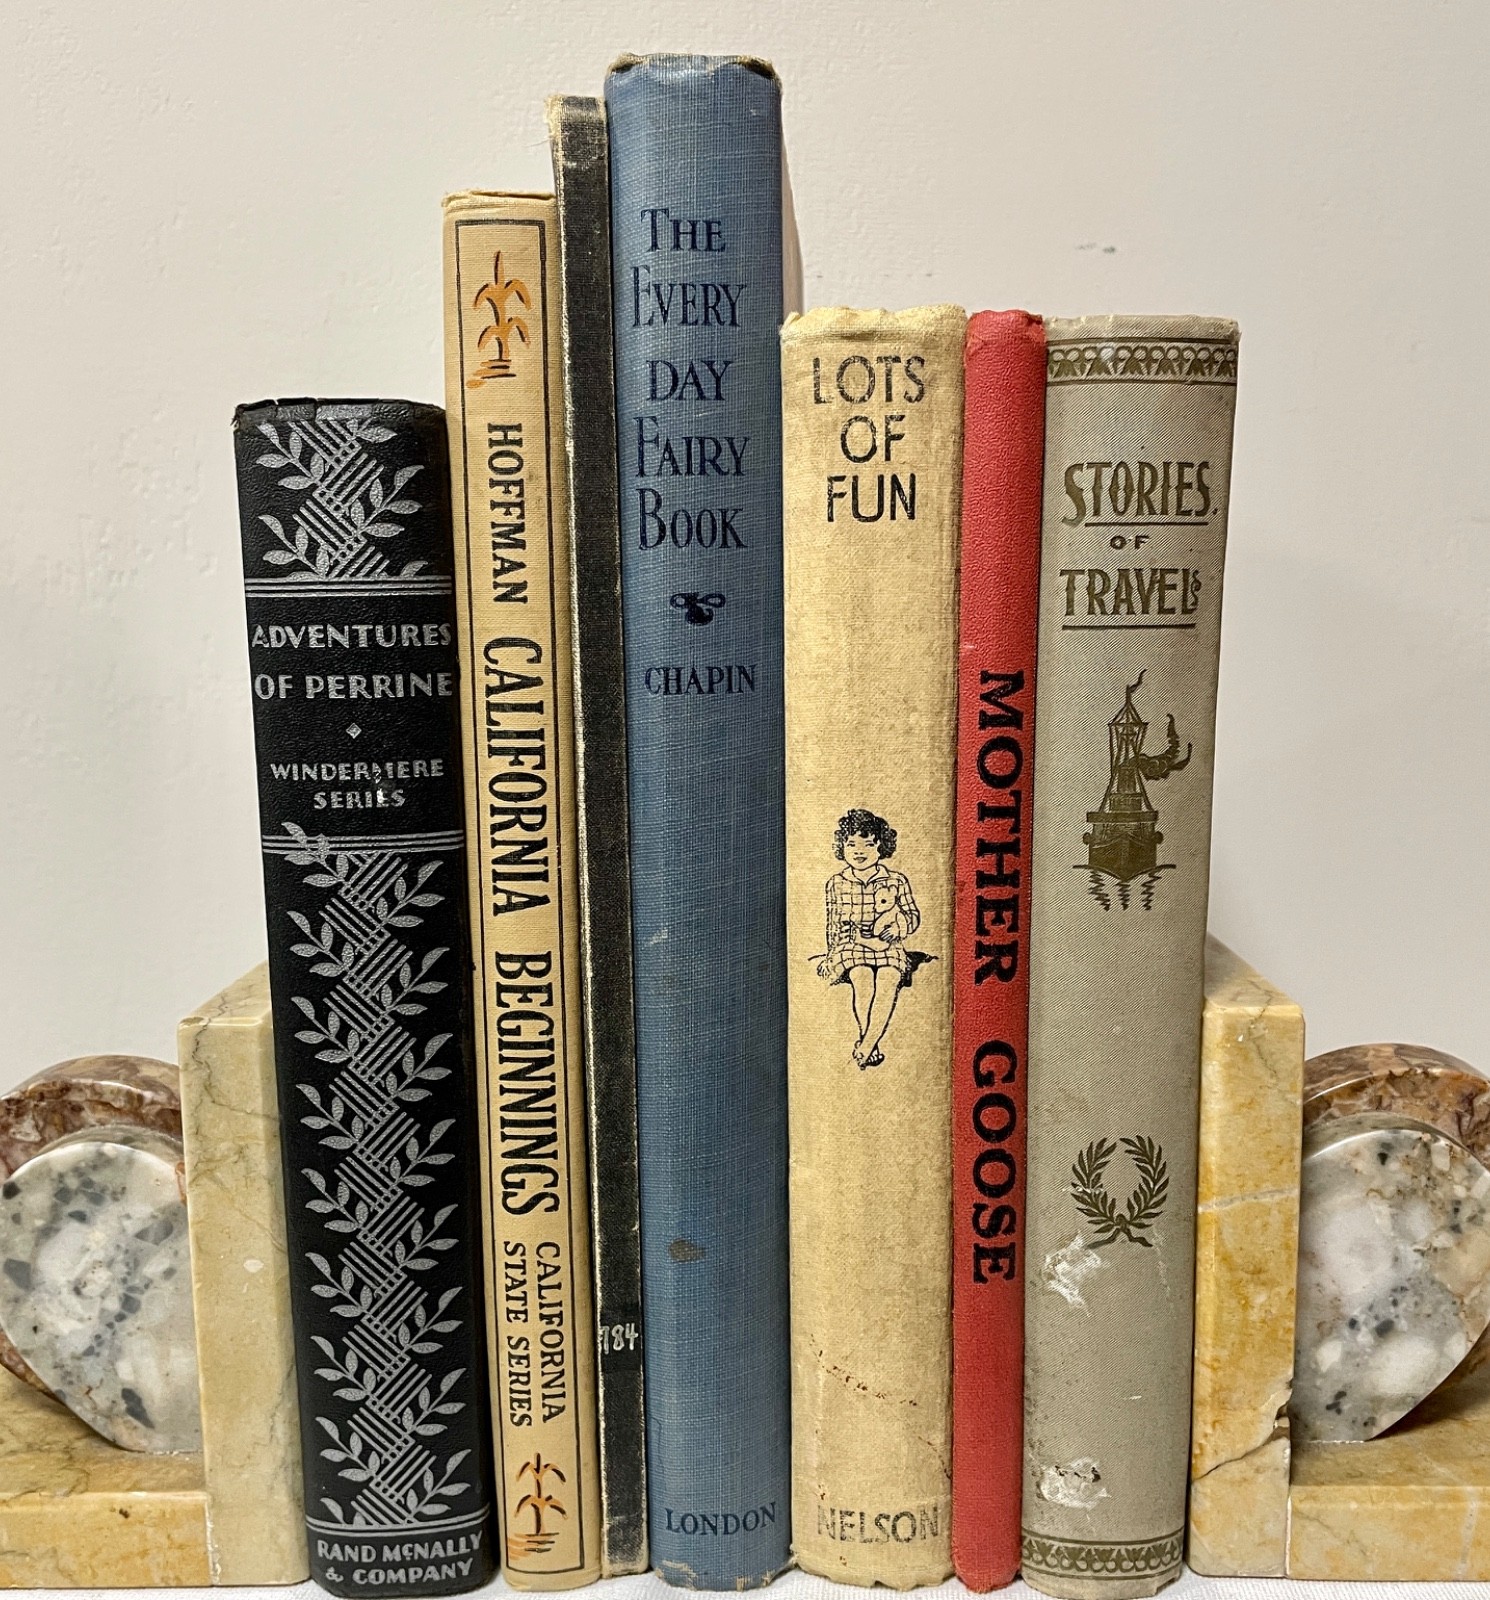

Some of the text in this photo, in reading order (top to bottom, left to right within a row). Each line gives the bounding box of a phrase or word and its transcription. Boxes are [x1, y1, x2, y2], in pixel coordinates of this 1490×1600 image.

[640, 208, 726, 252] THE
[632, 265, 746, 328] EVERY
[648, 359, 733, 401] DAY
[812, 355, 926, 405] LOTS
[633, 416, 750, 479] FAIRY
[840, 415, 906, 464] OF
[488, 423, 528, 604] HOFFMAN
[637, 487, 747, 551] BOOK
[827, 474, 916, 523] FUN
[1110, 535, 1149, 550] OF
[1060, 568, 1201, 616] TRAVELS
[251, 624, 452, 649] ADVENTURES
[254, 672, 453, 701] OF PERRINE
[644, 664, 757, 697] CHAPIN
[269, 758, 445, 783] WINDERMERE
[312, 790, 406, 812] SERIES
[483, 637, 561, 1216] CALIFORNIA BEGINNINGS
[971, 669, 1026, 1284] MOTHER GOOSE
[503, 1240, 533, 1428] STATE SERIES
[535, 1241, 567, 1424] CALIFORNIA
[665, 1502, 777, 1536] LONDON
[817, 1505, 938, 1544] NELSON
[317, 1539, 377, 1563] RAND
[325, 1557, 473, 1584] & COMPANY
